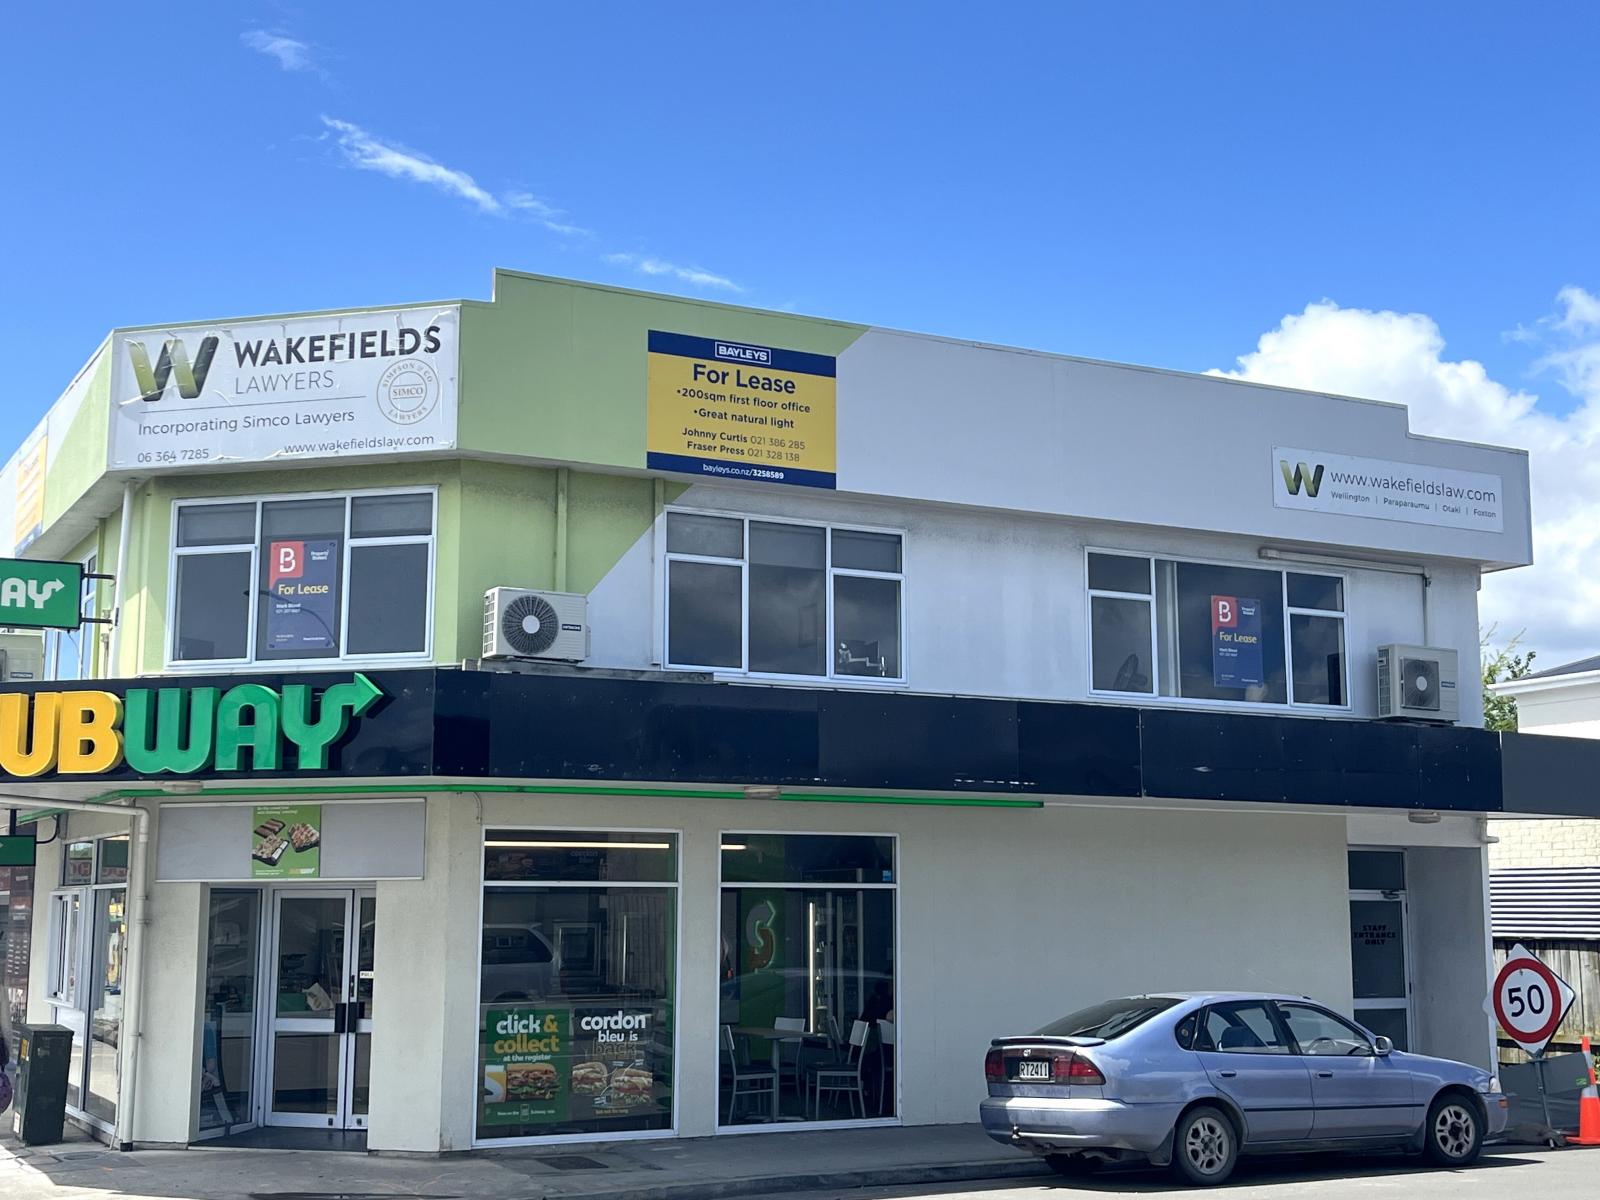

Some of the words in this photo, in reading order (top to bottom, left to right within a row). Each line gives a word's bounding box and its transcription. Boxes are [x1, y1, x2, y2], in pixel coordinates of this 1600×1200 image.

[234, 325, 441, 368] WAKEFIELDS
[719, 346, 767, 361] BAYLEYS
[235, 370, 335, 395] LAWYERS
[693, 363, 729, 385] For
[736, 369, 796, 394] Lease
[392, 386, 424, 397] SIMCO
[682, 387, 726, 403] 200sqm
[729, 393, 750, 405] first
[753, 397, 778, 409] floor
[781, 401, 811, 413] office
[138, 413, 238, 436] Incorporating
[243, 412, 290, 429] Simco
[295, 409, 355, 428] Lawyers
[698, 408, 728, 420] Great
[731, 413, 767, 426] natural
[770, 416, 795, 429] light
[284, 434, 435, 454] www.wakefieldslaw.com
[682, 428, 717, 440] Johnny
[720, 432, 748, 443] Curtis
[750, 436, 766, 444] 021
[769, 438, 786, 447] 386
[788, 440, 806, 450] 285
[137, 452, 153, 463] 06
[155, 450, 177, 462] 364
[181, 449, 210, 461] 7285
[687, 441, 717, 452] Fraser
[720, 445, 745, 456] Press
[747, 448, 763, 457] 021
[767, 450, 783, 460] 328
[785, 452, 800, 462] 138
[1330, 471, 1496, 503] www.wakefieldslaw.com
[1331, 491, 1370, 504] Wellington
[1383, 497, 1430, 511] Paraparaumu
[1473, 508, 1497, 519] Foxton
[278, 584, 296, 595] For
[298, 583, 329, 595] Lease
[1220, 631, 1232, 642] For
[1234, 633, 1257, 644] Lease
[1354, 931, 1396, 939] ENTRANCE
[1507, 984, 1545, 1018] 50
[496, 1013, 541, 1035] click
[543, 1013, 559, 1033] &
[581, 1010, 647, 1031] cordon
[494, 1033, 560, 1054] collect
[598, 1029, 625, 1043] bleu
[629, 1030, 638, 1042] is
[512, 1054, 524, 1062] the
[525, 1053, 551, 1063] register
